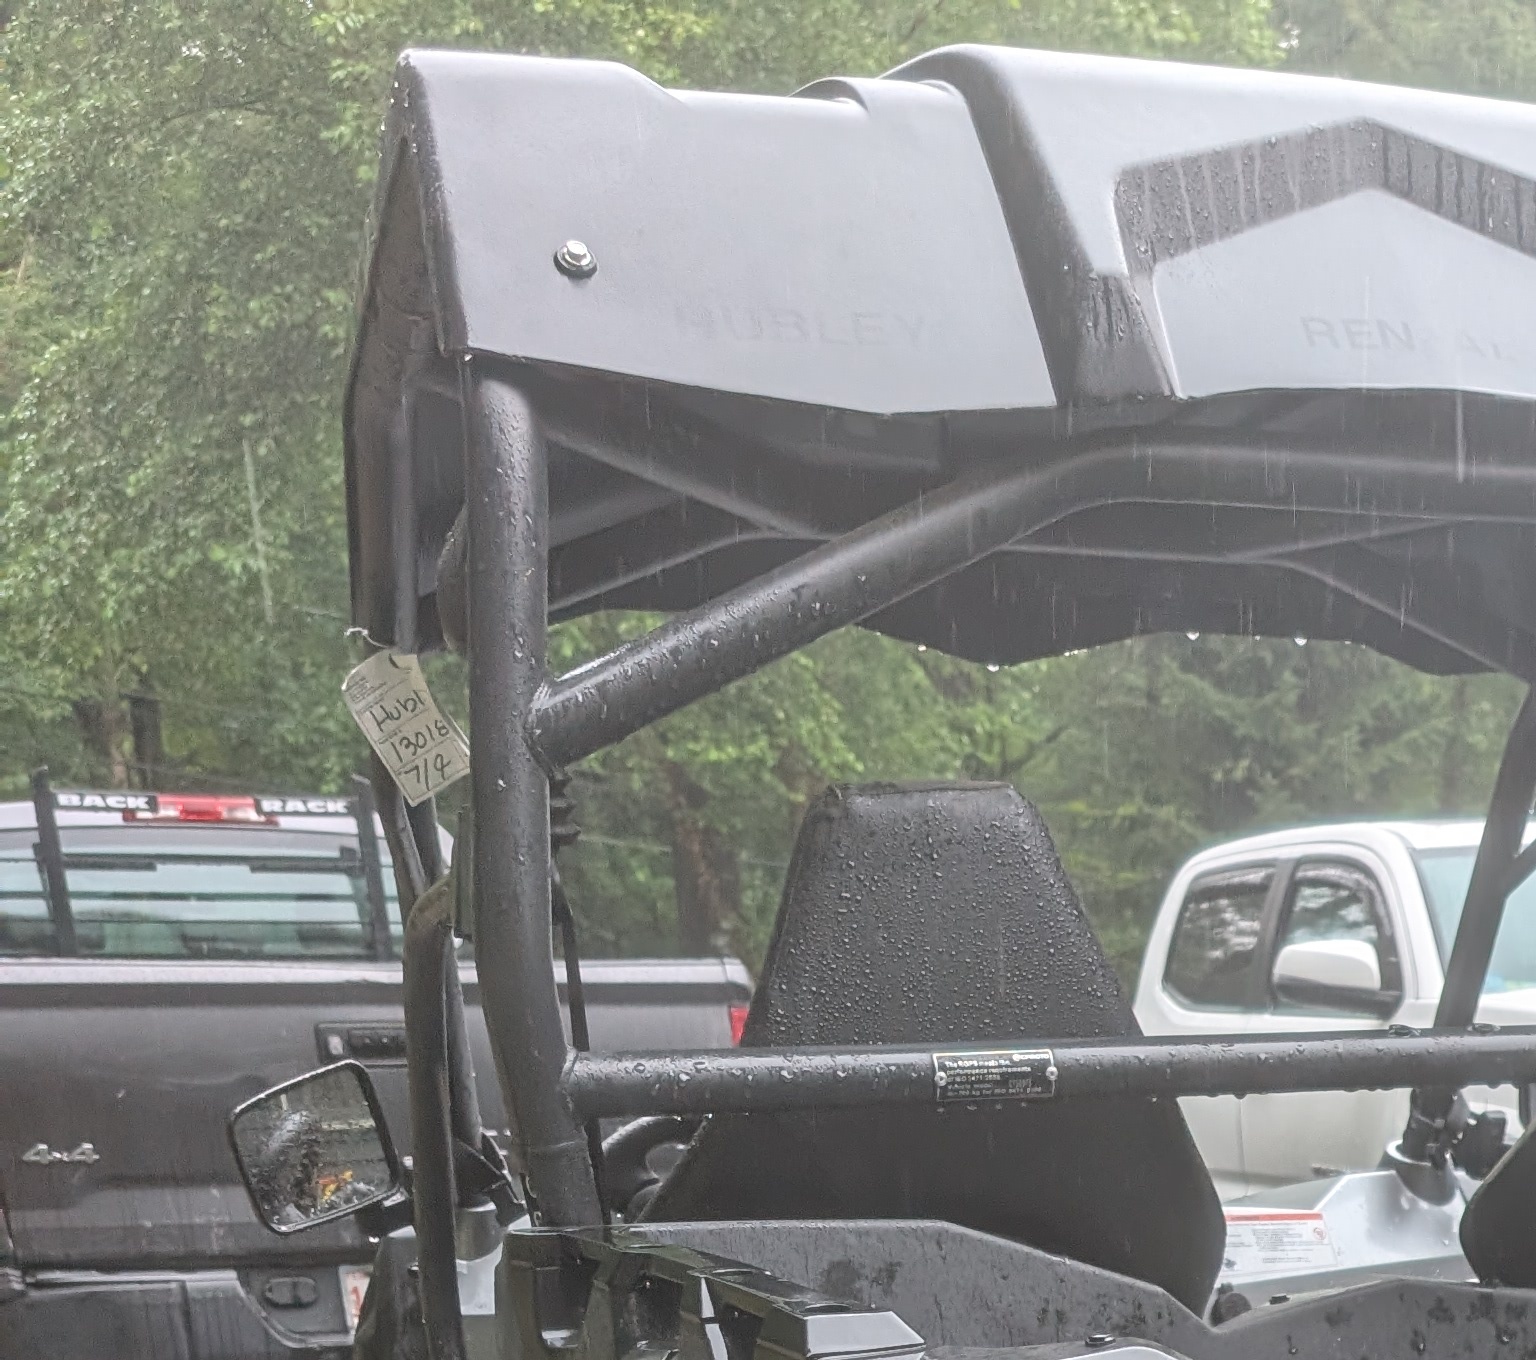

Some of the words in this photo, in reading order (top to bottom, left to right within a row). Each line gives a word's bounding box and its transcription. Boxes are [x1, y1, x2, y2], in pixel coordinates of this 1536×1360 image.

[1298, 315, 1520, 363] RENAL
[390, 719, 450, 764] 13018
[57, 794, 151, 810] BACK
[261, 798, 351, 814] RACK
[22, 1142, 101, 1165] 4x4
